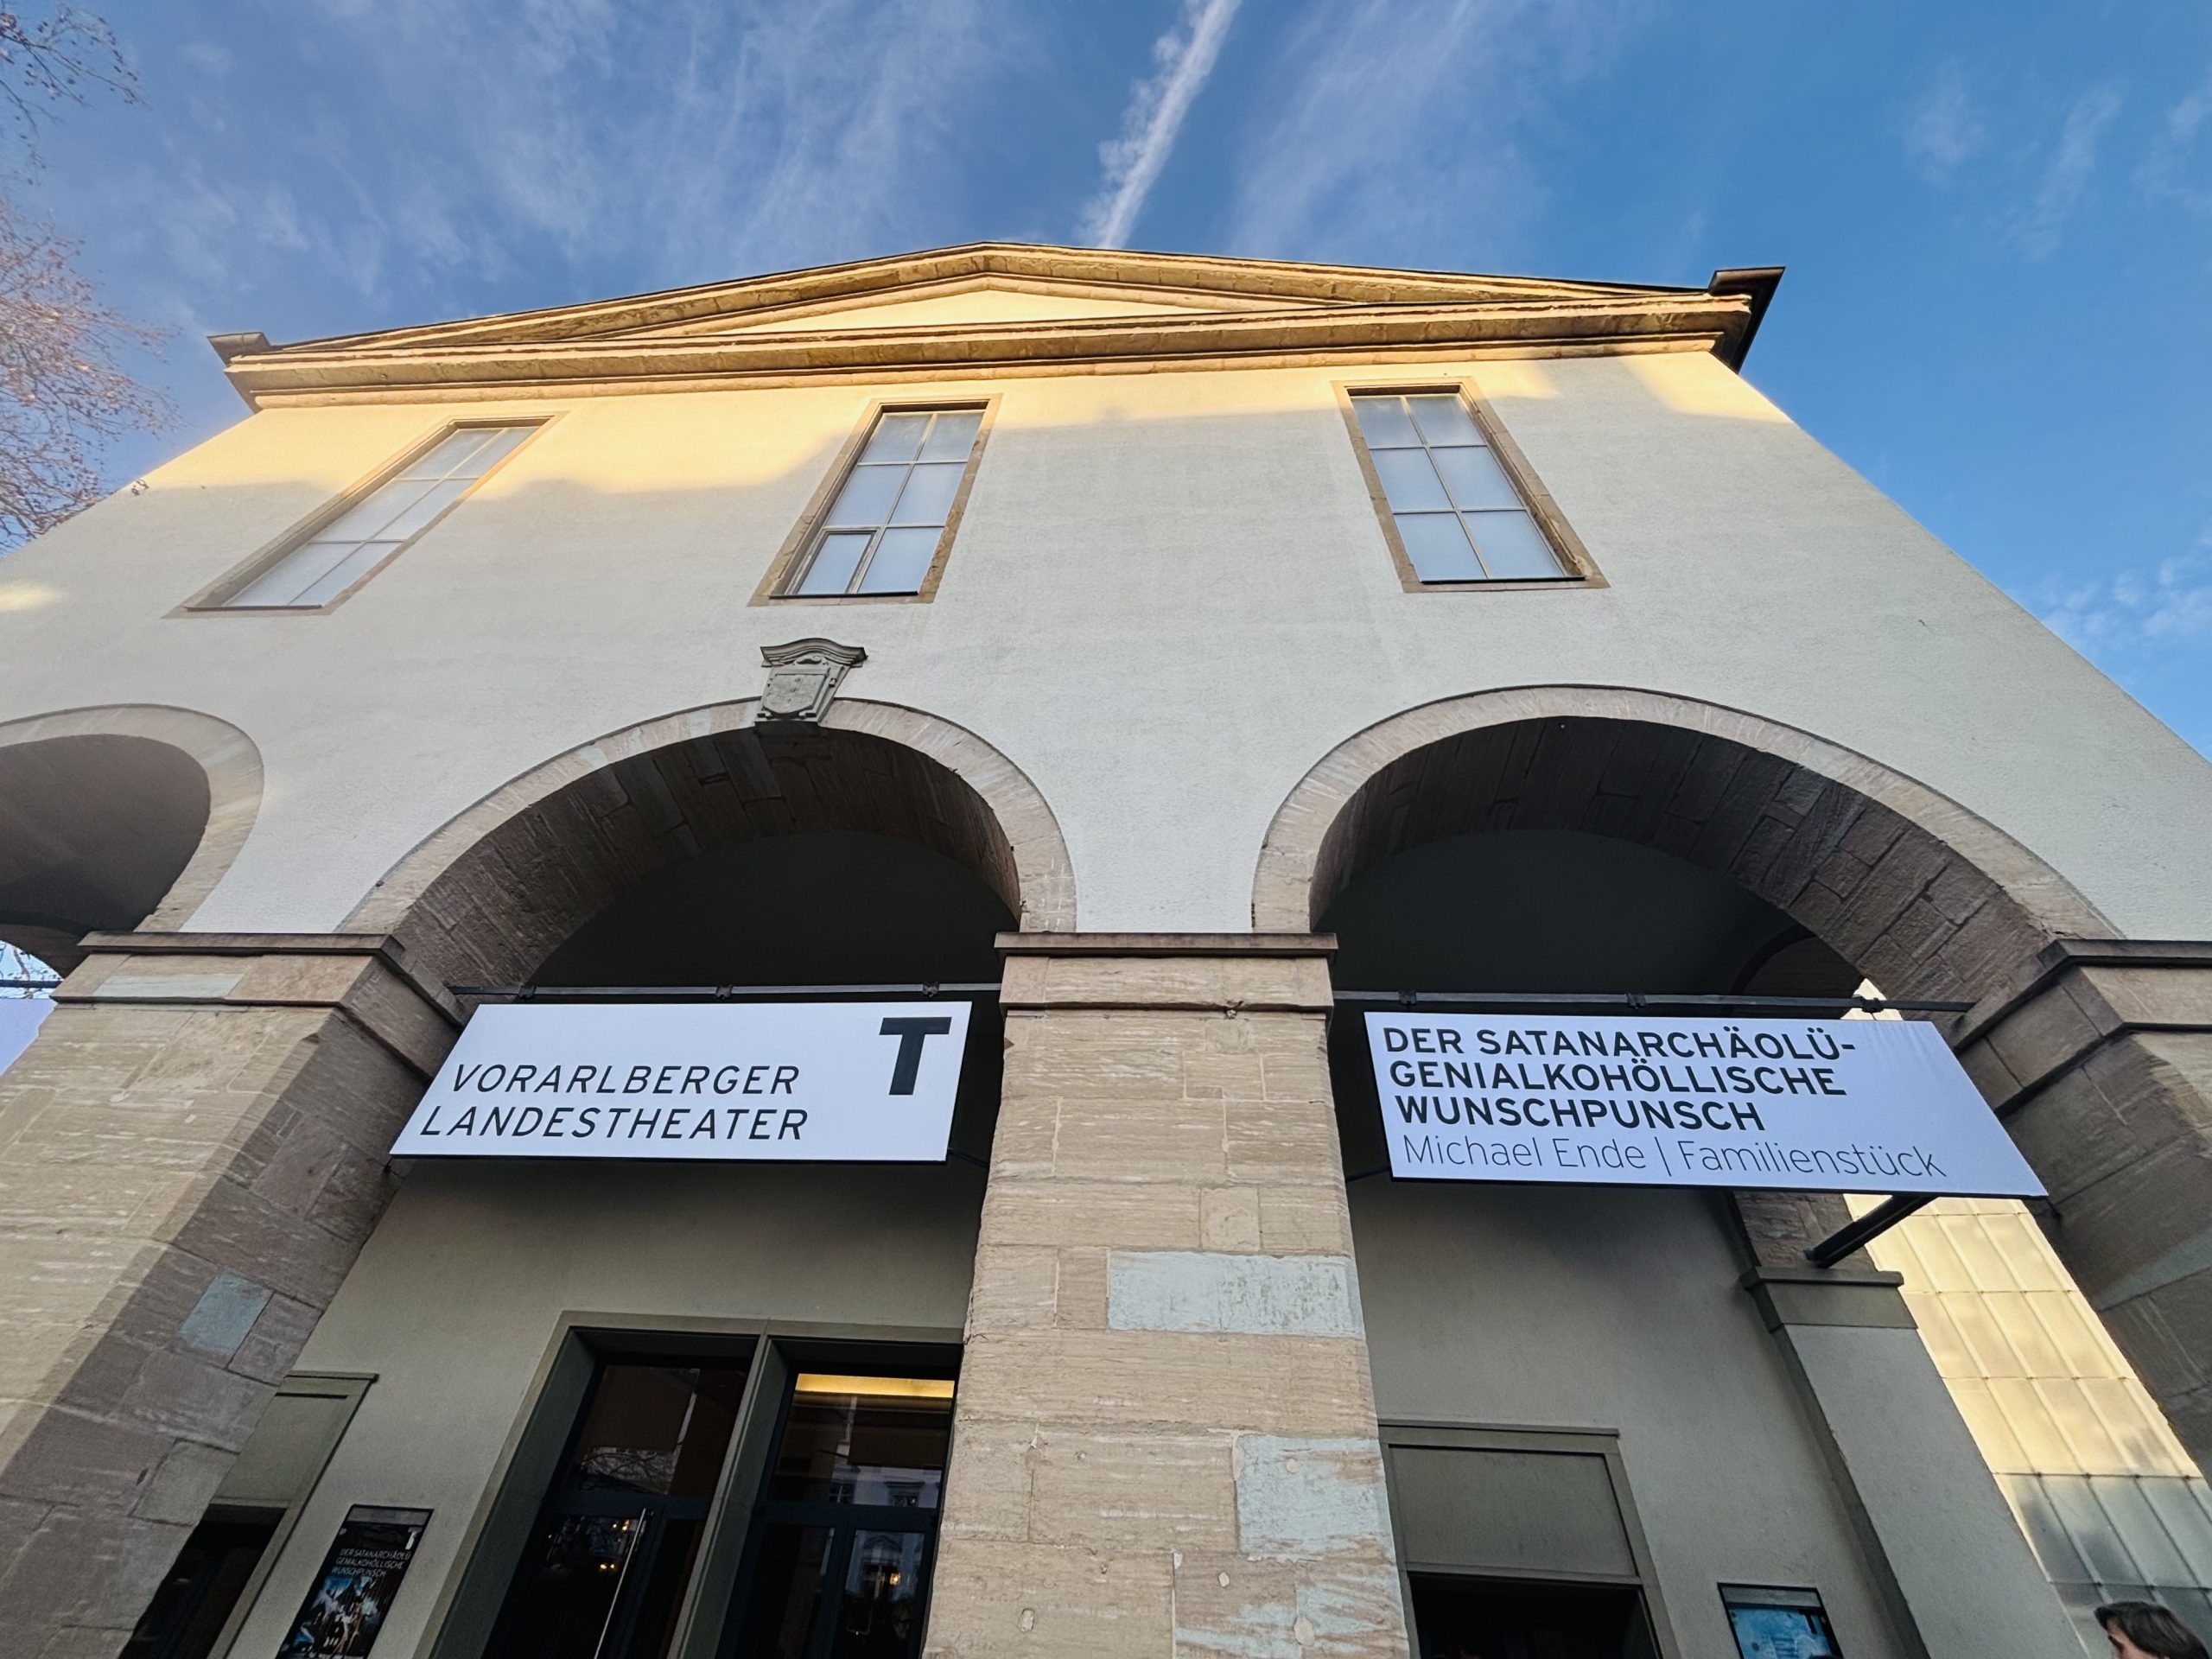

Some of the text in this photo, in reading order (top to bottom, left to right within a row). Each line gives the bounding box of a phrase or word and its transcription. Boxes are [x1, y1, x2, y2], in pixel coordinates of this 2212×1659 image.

[879, 1016, 952, 1096] T
[1382, 1026, 1856, 1061] DER SATANARCHÄOLÜ-
[453, 1064, 800, 1095] VORARLBERGER
[1389, 1056, 1849, 1097] GENIALKOHÖLLISCHE
[420, 1105, 808, 1141] LANDESTHEATER
[1394, 1095, 1766, 1131] WUNSCHPUNSCH
[1403, 1133, 1543, 1168] Michael
[1552, 1137, 1647, 1169] Ende
[1676, 1140, 1948, 1179] Familienstück
